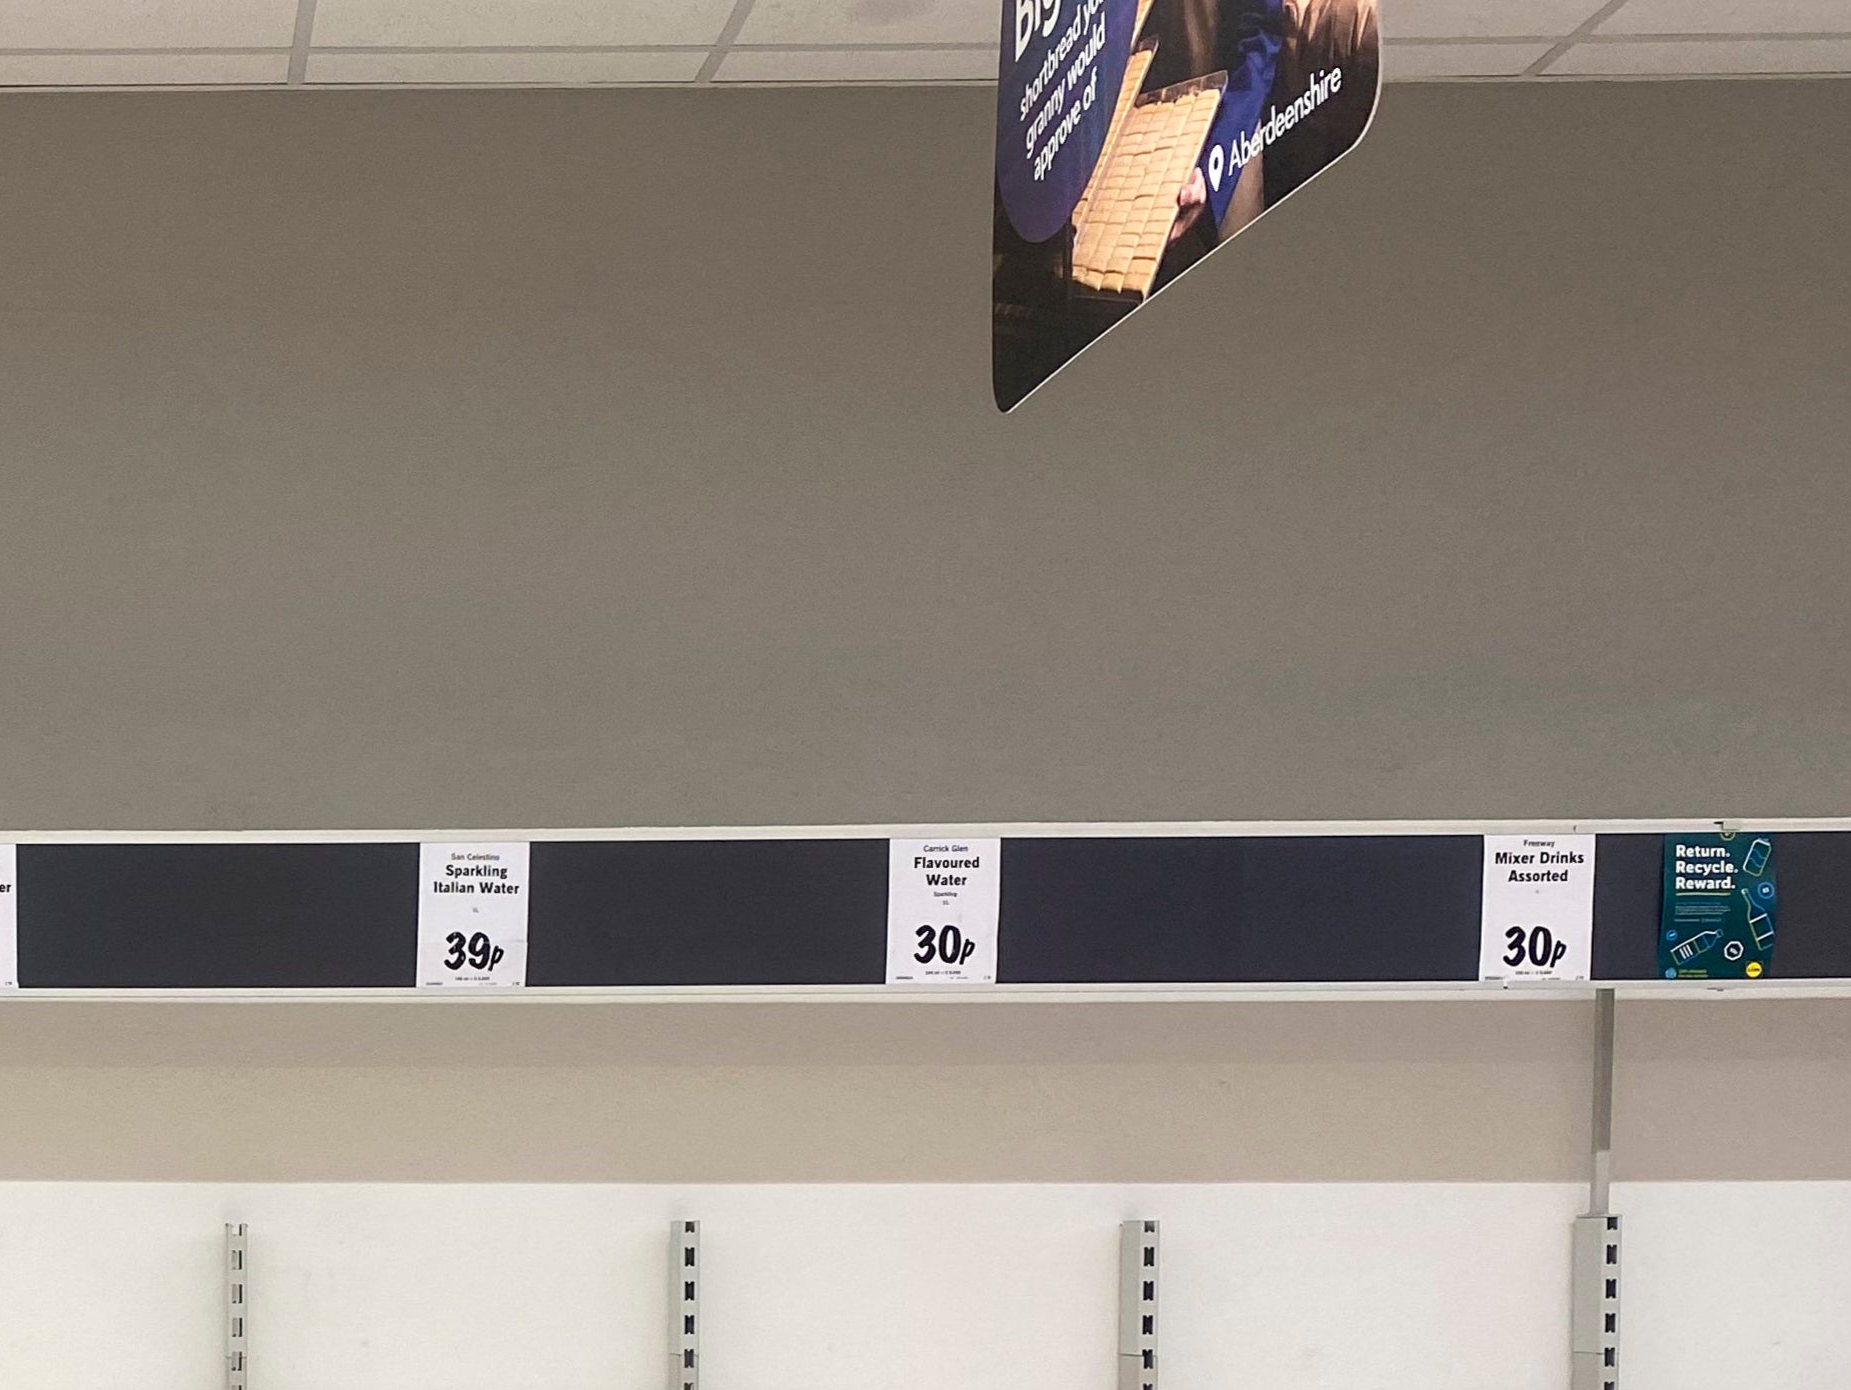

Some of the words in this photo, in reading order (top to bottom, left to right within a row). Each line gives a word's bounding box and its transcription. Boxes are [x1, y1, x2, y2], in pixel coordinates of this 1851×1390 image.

[1020, 4, 1081, 121] shortbread
[1026, 79, 1065, 159] granny
[1067, 11, 1105, 90] would
[1034, 100, 1081, 181] approve
[1083, 66, 1097, 111] of
[1228, 66, 1342, 176] Aberdeenshire
[1523, 839, 1555, 848] Freeway
[1675, 844, 1731, 858] Return.
[913, 856, 980, 869] Flavoured
[1495, 852, 1535, 865] Mixer
[1539, 851, 1585, 864] Drinks
[445, 864, 507, 880] Sparkling
[1508, 870, 1569, 882] Assorted
[1675, 860, 1739, 876] Recycle.
[433, 881, 475, 894] Italian
[479, 882, 520, 894] Water
[926, 874, 967, 886] Water
[1675, 876, 1736, 890] Reward.
[443, 931, 505, 972] 39p
[913, 925, 975, 966] 30p
[1503, 926, 1567, 968] 30p
